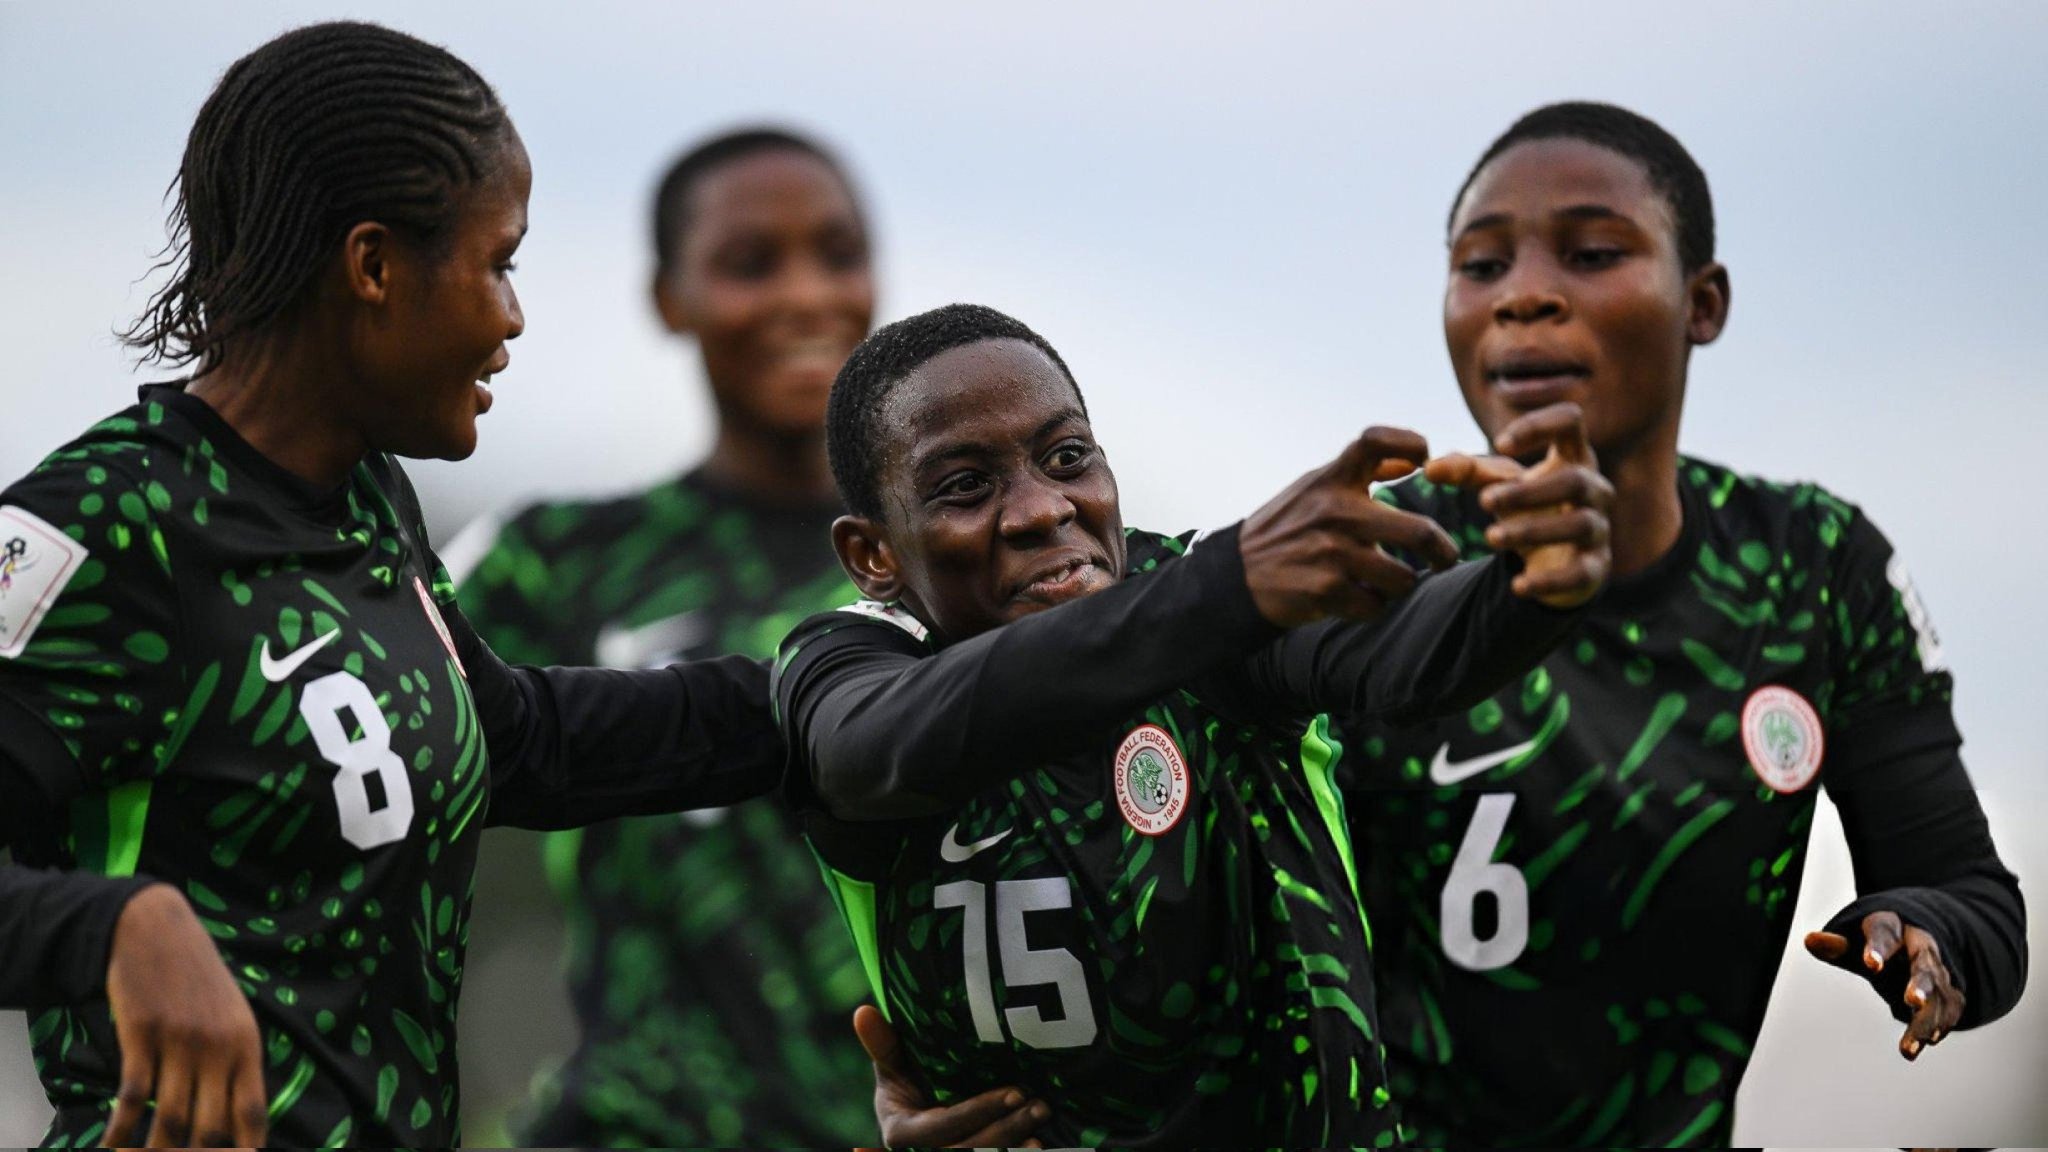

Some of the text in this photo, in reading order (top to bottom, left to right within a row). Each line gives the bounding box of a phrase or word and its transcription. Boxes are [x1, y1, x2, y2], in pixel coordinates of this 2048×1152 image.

[299, 670, 415, 851] 8
[1116, 731, 1183, 829] NIGERIA FOOTBALL FEDERATION
[1164, 799, 1180, 821] 1945
[934, 877, 1098, 1049] 15
[1441, 792, 1529, 971] 6
